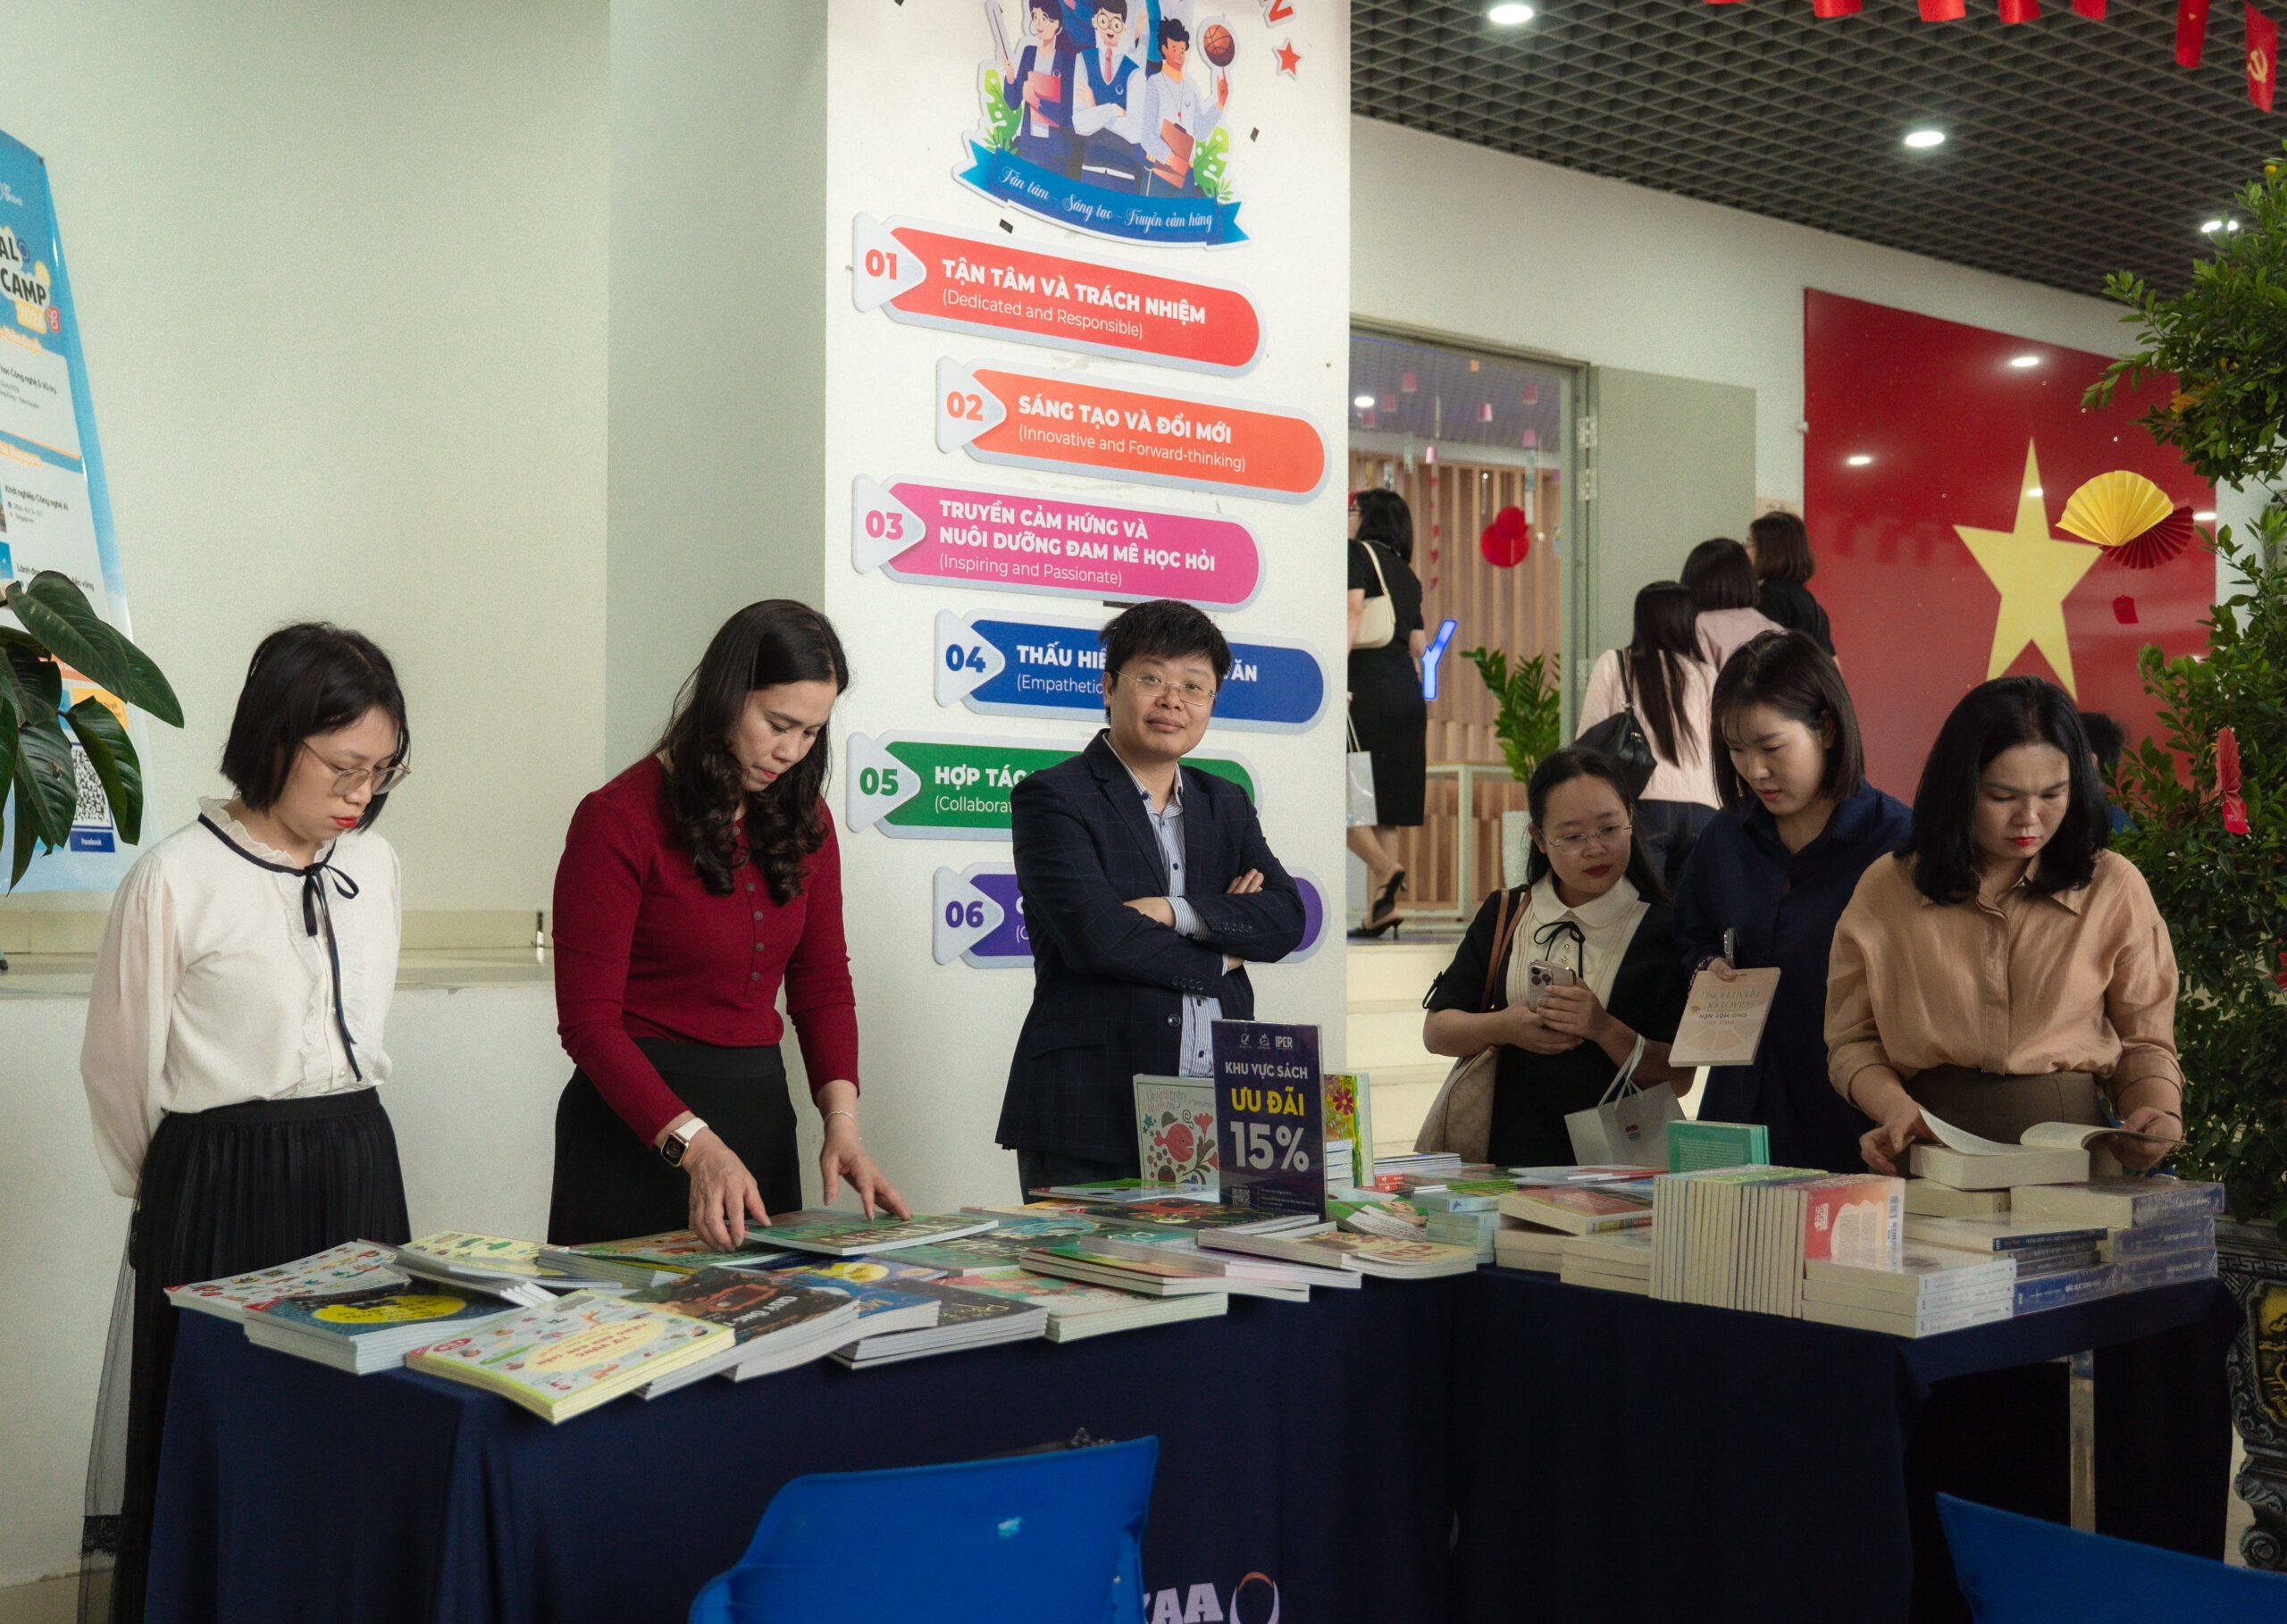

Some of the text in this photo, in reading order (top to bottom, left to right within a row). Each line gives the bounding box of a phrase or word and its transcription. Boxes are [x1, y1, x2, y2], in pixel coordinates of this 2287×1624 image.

[1026, 180, 1050, 203] tâm
[1061, 193, 1093, 222] Sáng
[1096, 204, 1114, 221] tạo
[1123, 206, 1163, 234] Truyền
[1165, 212, 1186, 229] cảm
[1187, 211, 1214, 233] hứng
[866, 249, 897, 280] 01
[942, 257, 1205, 325] TẬN TÂM VÀ TRÁCH NHIỆM
[943, 289, 1143, 339] (Dedicated and Responsible)
[947, 391, 983, 421] 02
[1019, 393, 1231, 443] SÁNG TẠO VÀ ĐỔI MỚI
[1019, 423, 1244, 472] (Innovative and Forward-thinking)
[866, 510, 903, 540] 03
[940, 500, 1148, 539] TRUYỀN CẢM HỨNG VÀ
[940, 525, 1214, 571] NUÔI DƯỠNG ĐAM MÊ HỌC HỎI
[940, 553, 1121, 587] (Inspiring and Passionate)
[946, 644, 985, 673] 04
[1017, 641, 1072, 666] THẤU
[1224, 659, 1257, 682] ĂN
[860, 767, 899, 796] 05
[935, 764, 980, 790] HỢP
[935, 796, 1012, 813] (Collaborat
[945, 901, 984, 928] 06
[1275, 1035, 1294, 1048] IPER
[1225, 1061, 1308, 1079] KHU VỰC SÁCH
[1231, 1087, 1304, 1116] ƯU ĐÃI
[1230, 1121, 1310, 1172] 15%
